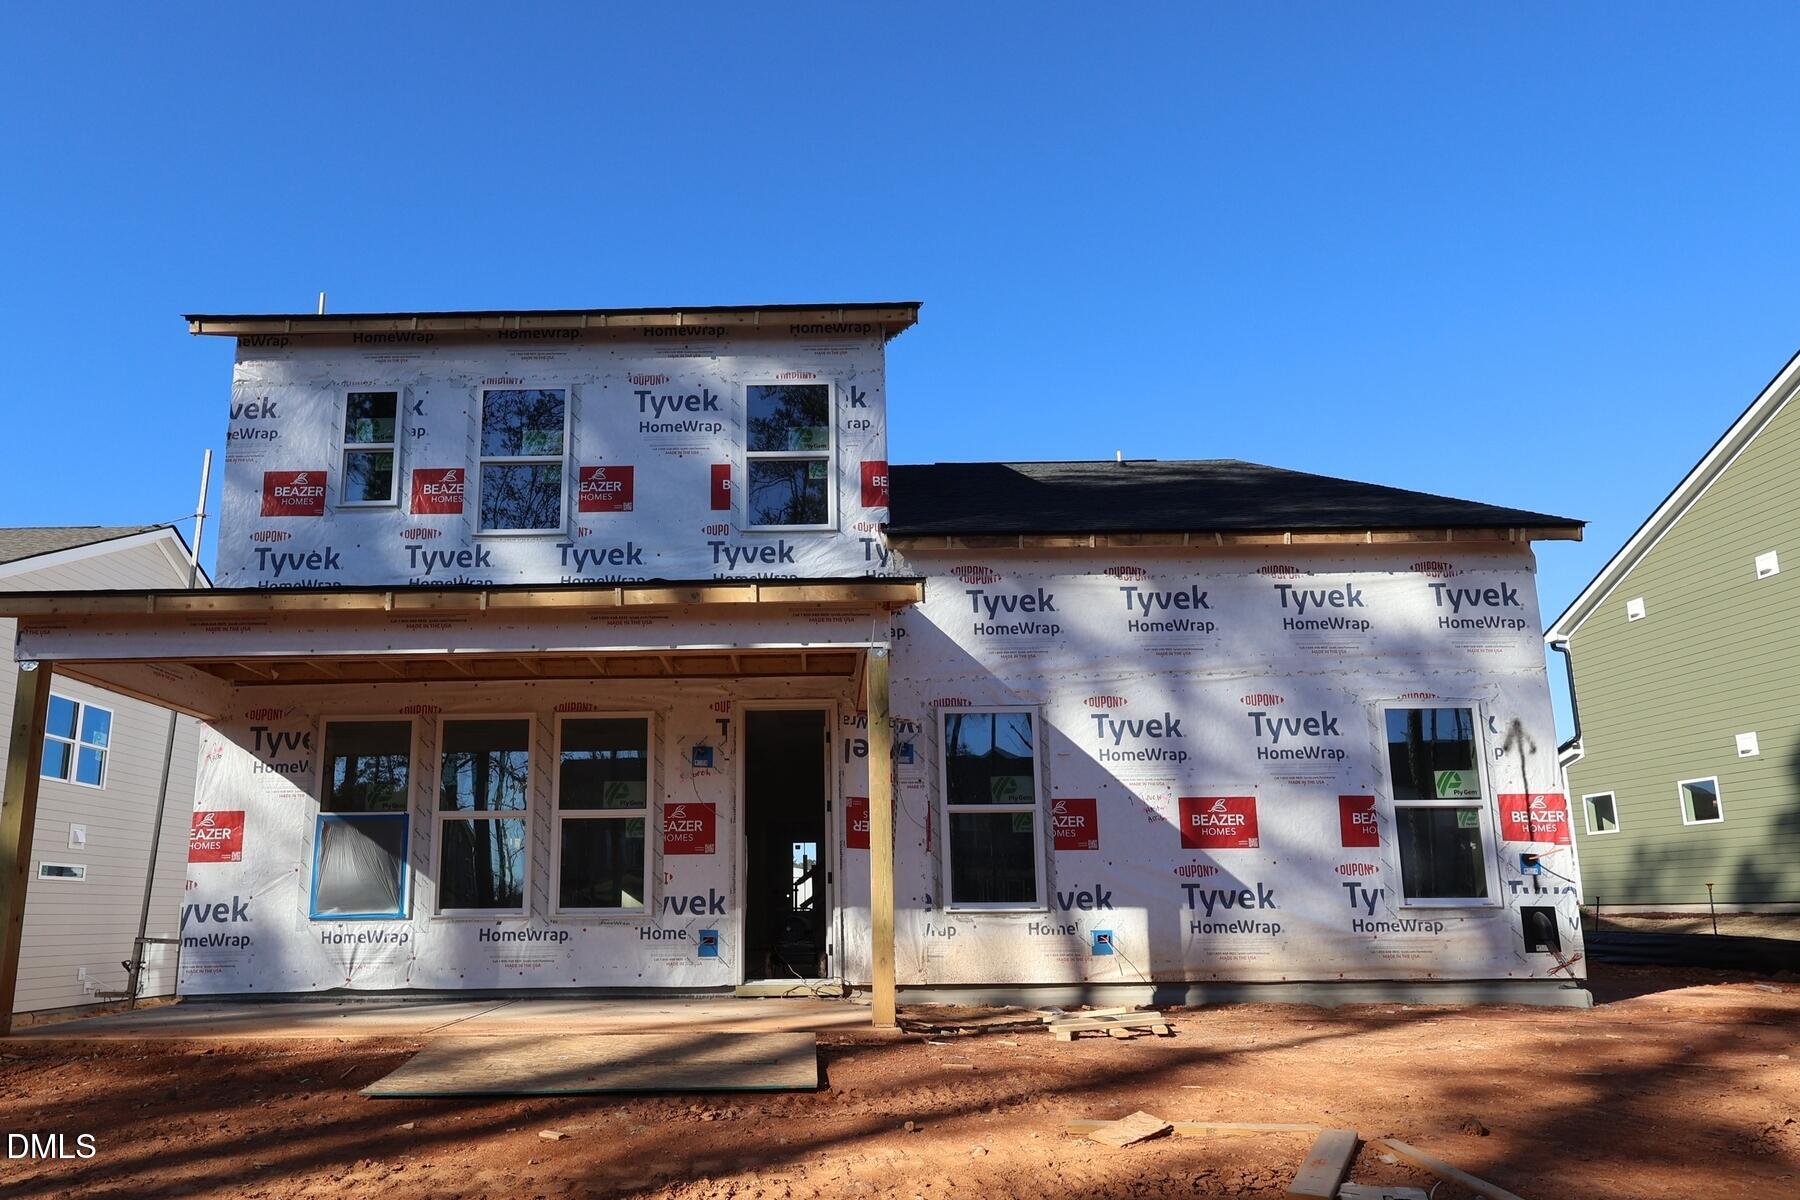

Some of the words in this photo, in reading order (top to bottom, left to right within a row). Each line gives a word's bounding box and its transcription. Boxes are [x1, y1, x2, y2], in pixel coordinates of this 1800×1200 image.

[498, 328, 580, 340] HomeWrap
[644, 326, 726, 338] HomeWrap
[790, 323, 872, 335] HomeWrap
[237, 335, 288, 348] eWrap
[353, 332, 434, 344] HomeWrap
[229, 397, 277, 420] vek
[634, 389, 719, 419] Tyvek
[639, 421, 722, 434] HomeWrap
[227, 428, 279, 441] eWrap
[274, 486, 324, 497] BEAZER
[423, 484, 464, 495] BEAZE
[581, 481, 622, 492] EAZER
[281, 498, 314, 506] HOMES
[431, 495, 463, 503] HOMES
[581, 493, 613, 501] HOMES
[254, 530, 287, 543] DUPONT
[405, 527, 437, 540] DUPONT
[706, 524, 729, 536] DUPO
[405, 544, 491, 575] Tyvek
[556, 542, 643, 573] Tyvek
[707, 540, 795, 570] Tyvek
[255, 547, 341, 577] Tyvek
[966, 588, 1055, 620] Tyvek
[1120, 585, 1209, 617] Tyvek
[1274, 583, 1364, 615] Tyvek
[1428, 582, 1520, 614] Tyvek
[973, 622, 1060, 636] HomeWrap
[1128, 619, 1215, 634] HomeWrap
[1283, 617, 1370, 632] HomeWrap
[1438, 616, 1526, 631] HomeWrap
[1089, 695, 1123, 708] DUPONT
[1245, 693, 1279, 706] DUPONT
[714, 701, 731, 713] DUP
[250, 708, 283, 721] DUPONT
[1091, 712, 1183, 745] Tyvek
[1248, 710, 1340, 744] Tyvek
[1099, 748, 1187, 763] HomeWrap
[1257, 746, 1345, 762] HomeWrap
[253, 760, 309, 774] Home
[1052, 816, 1085, 827] AZER
[1192, 815, 1245, 826] BEAZER
[1352, 813, 1377, 824] BEA
[1511, 811, 1565, 823] BEAZER
[664, 820, 703, 832] EAZER
[1201, 828, 1236, 836] HOMES
[1522, 824, 1557, 832] HOMES
[189, 829, 232, 840] EAZER
[664, 834, 694, 842] OMES
[1052, 829, 1076, 837] OMES
[1179, 865, 1213, 878] DUPONT
[1340, 862, 1375, 876] DUPONT
[663, 888, 726, 915] vek
[1057, 884, 1113, 911] vek
[1181, 882, 1276, 917] Tyvek
[182, 896, 249, 931] yvek
[1028, 922, 1079, 936] Home
[1190, 920, 1281, 936] HomeWrap
[1352, 918, 1443, 935] HomeWrap
[321, 930, 409, 946] HomeWrap
[479, 927, 569, 944] HomeWrap
[640, 927, 687, 940] Home
[183, 933, 250, 949] meWrap
